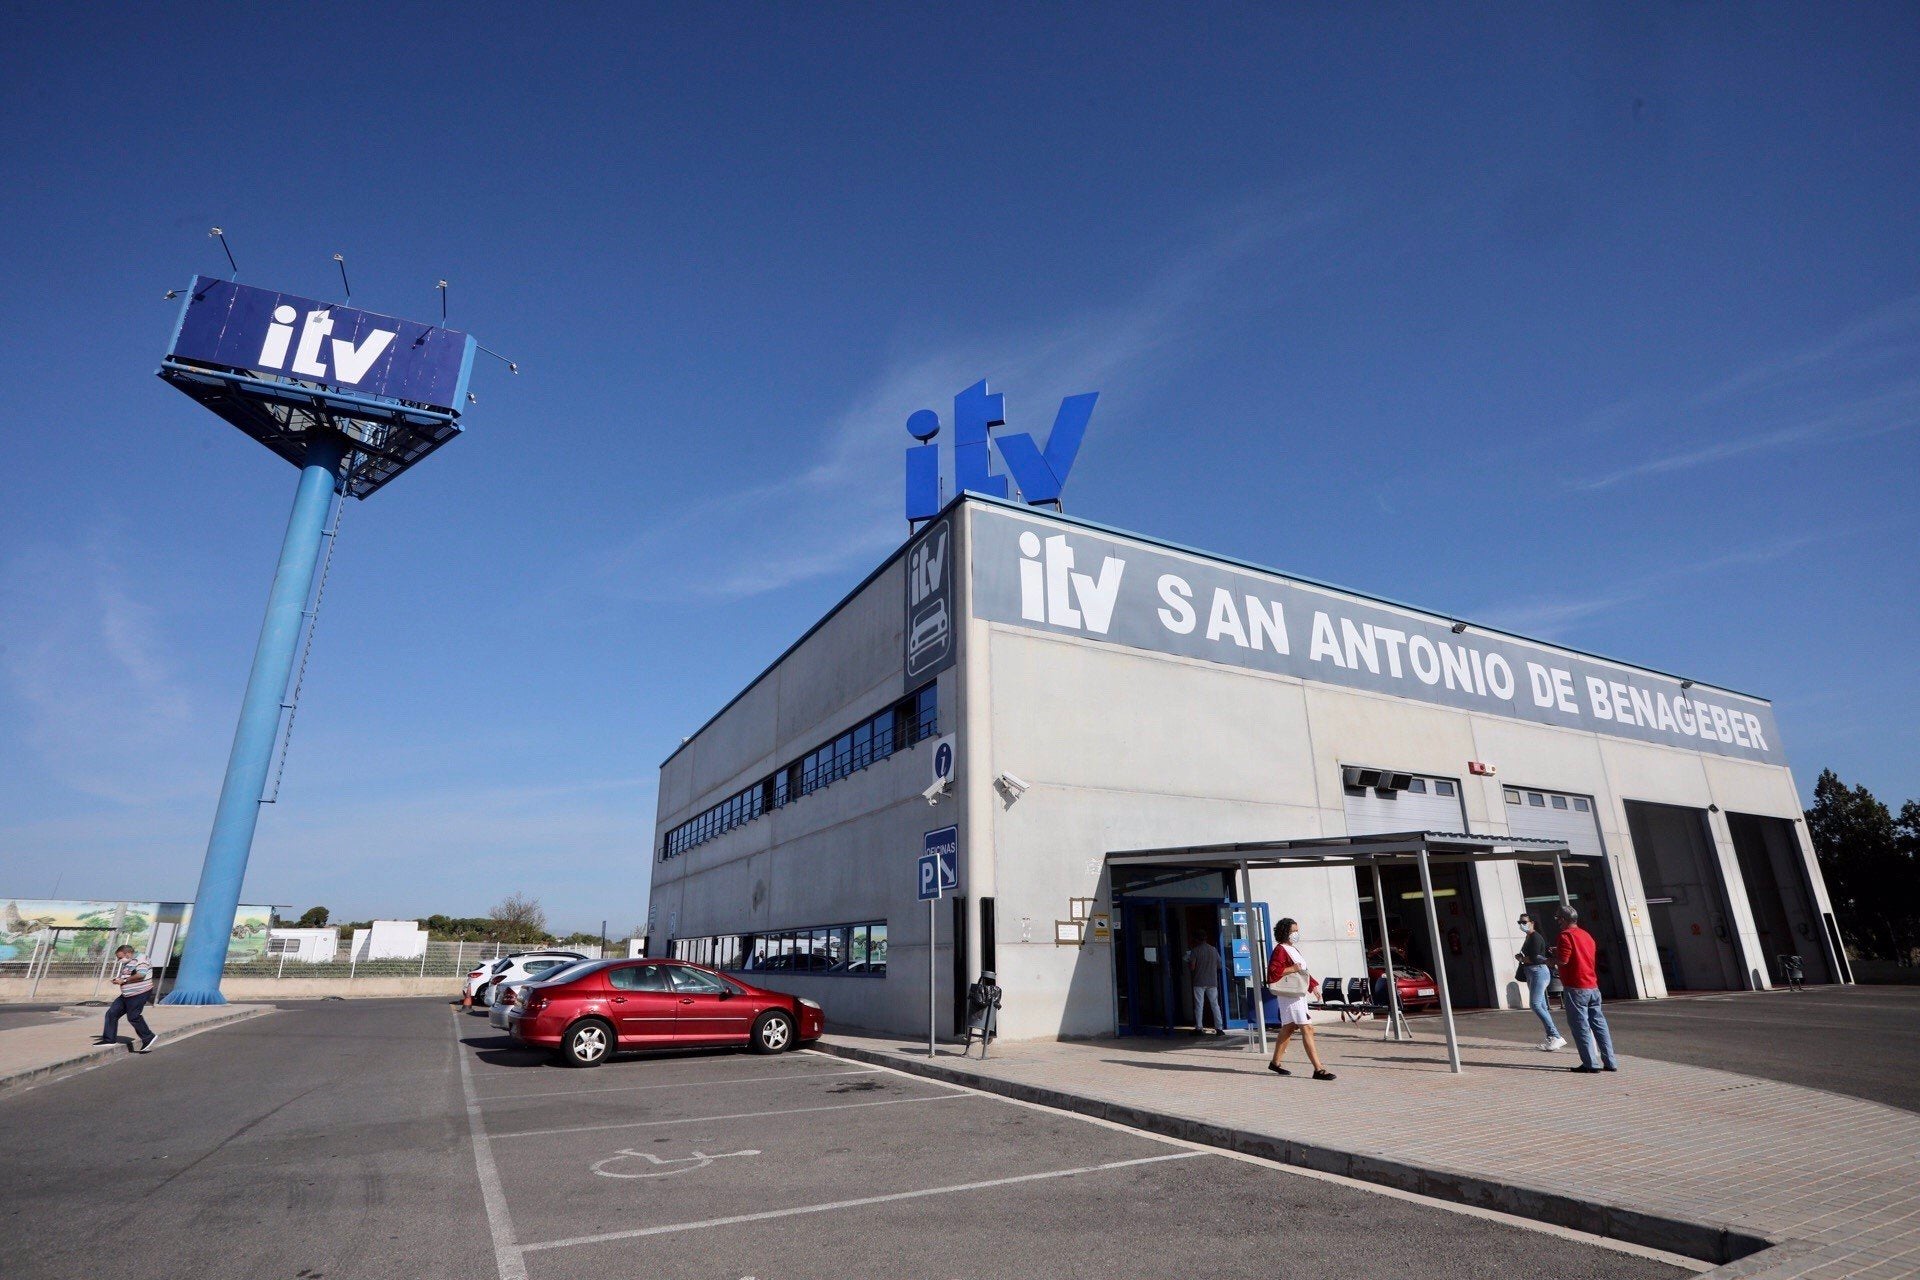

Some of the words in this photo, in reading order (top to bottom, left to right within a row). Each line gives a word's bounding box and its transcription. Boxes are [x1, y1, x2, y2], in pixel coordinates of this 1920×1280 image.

[258, 304, 397, 385] itv
[905, 378, 1100, 521] itv
[911, 531, 947, 607] itv
[1018, 531, 1126, 635] itv
[1156, 573, 1290, 656] SAN
[1309, 610, 1515, 701] ANTONIO
[1526, 661, 1579, 715] DE
[1585, 675, 1769, 751] BENAGEBER
[921, 862, 934, 895] P
